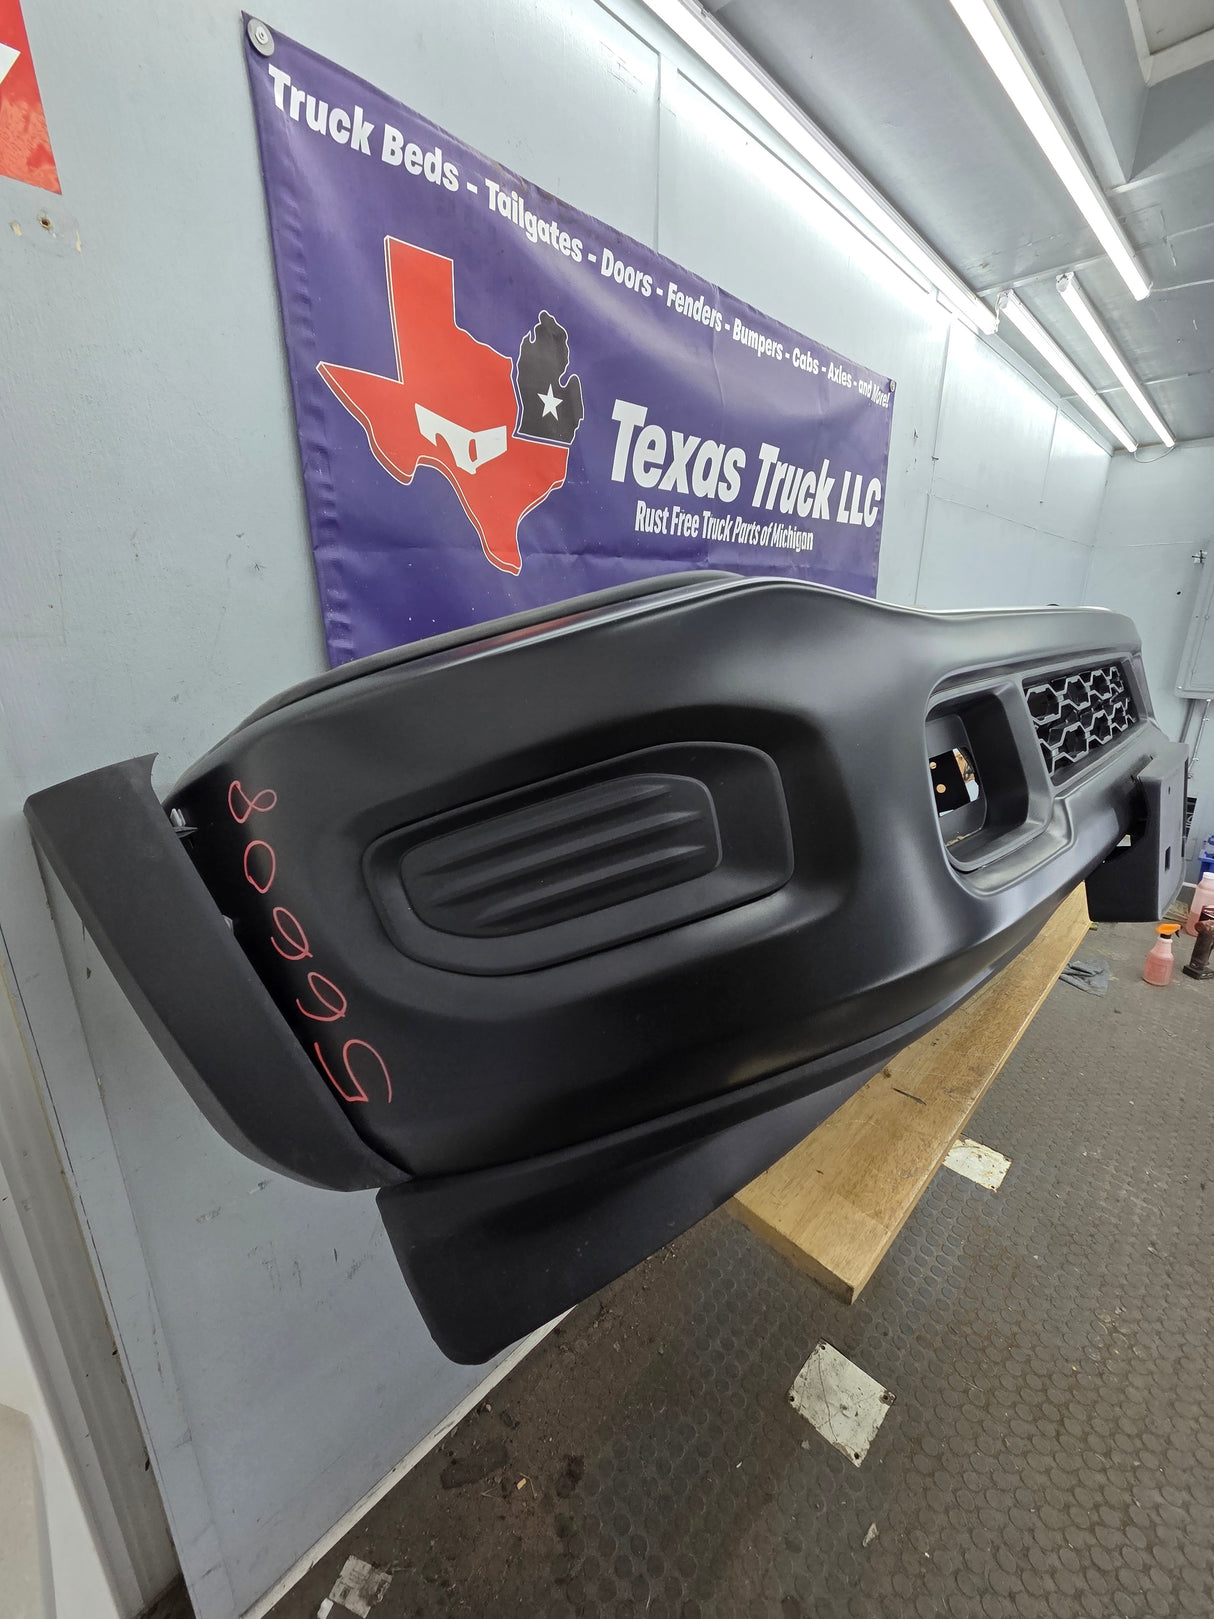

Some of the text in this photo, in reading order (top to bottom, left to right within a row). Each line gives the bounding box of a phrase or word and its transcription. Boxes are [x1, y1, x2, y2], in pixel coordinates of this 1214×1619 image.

[268, 63, 375, 156] Truck
[381, 123, 459, 192] Beds
[485, 178, 583, 263] Tailgates
[601, 247, 653, 297] Doors
[666, 281, 723, 332] Fenders
[732, 317, 784, 361] Bumpers
[792, 347, 820, 375] Cabs
[827, 362, 852, 388] Axles
[858, 379, 872, 399] and
[870, 383, 890, 409] More!
[611, 398, 882, 528] Texas Truck LLC
[635, 500, 814, 553] Rust Free Truck Parts of Michigan
[228, 780, 392, 1103] 56608
